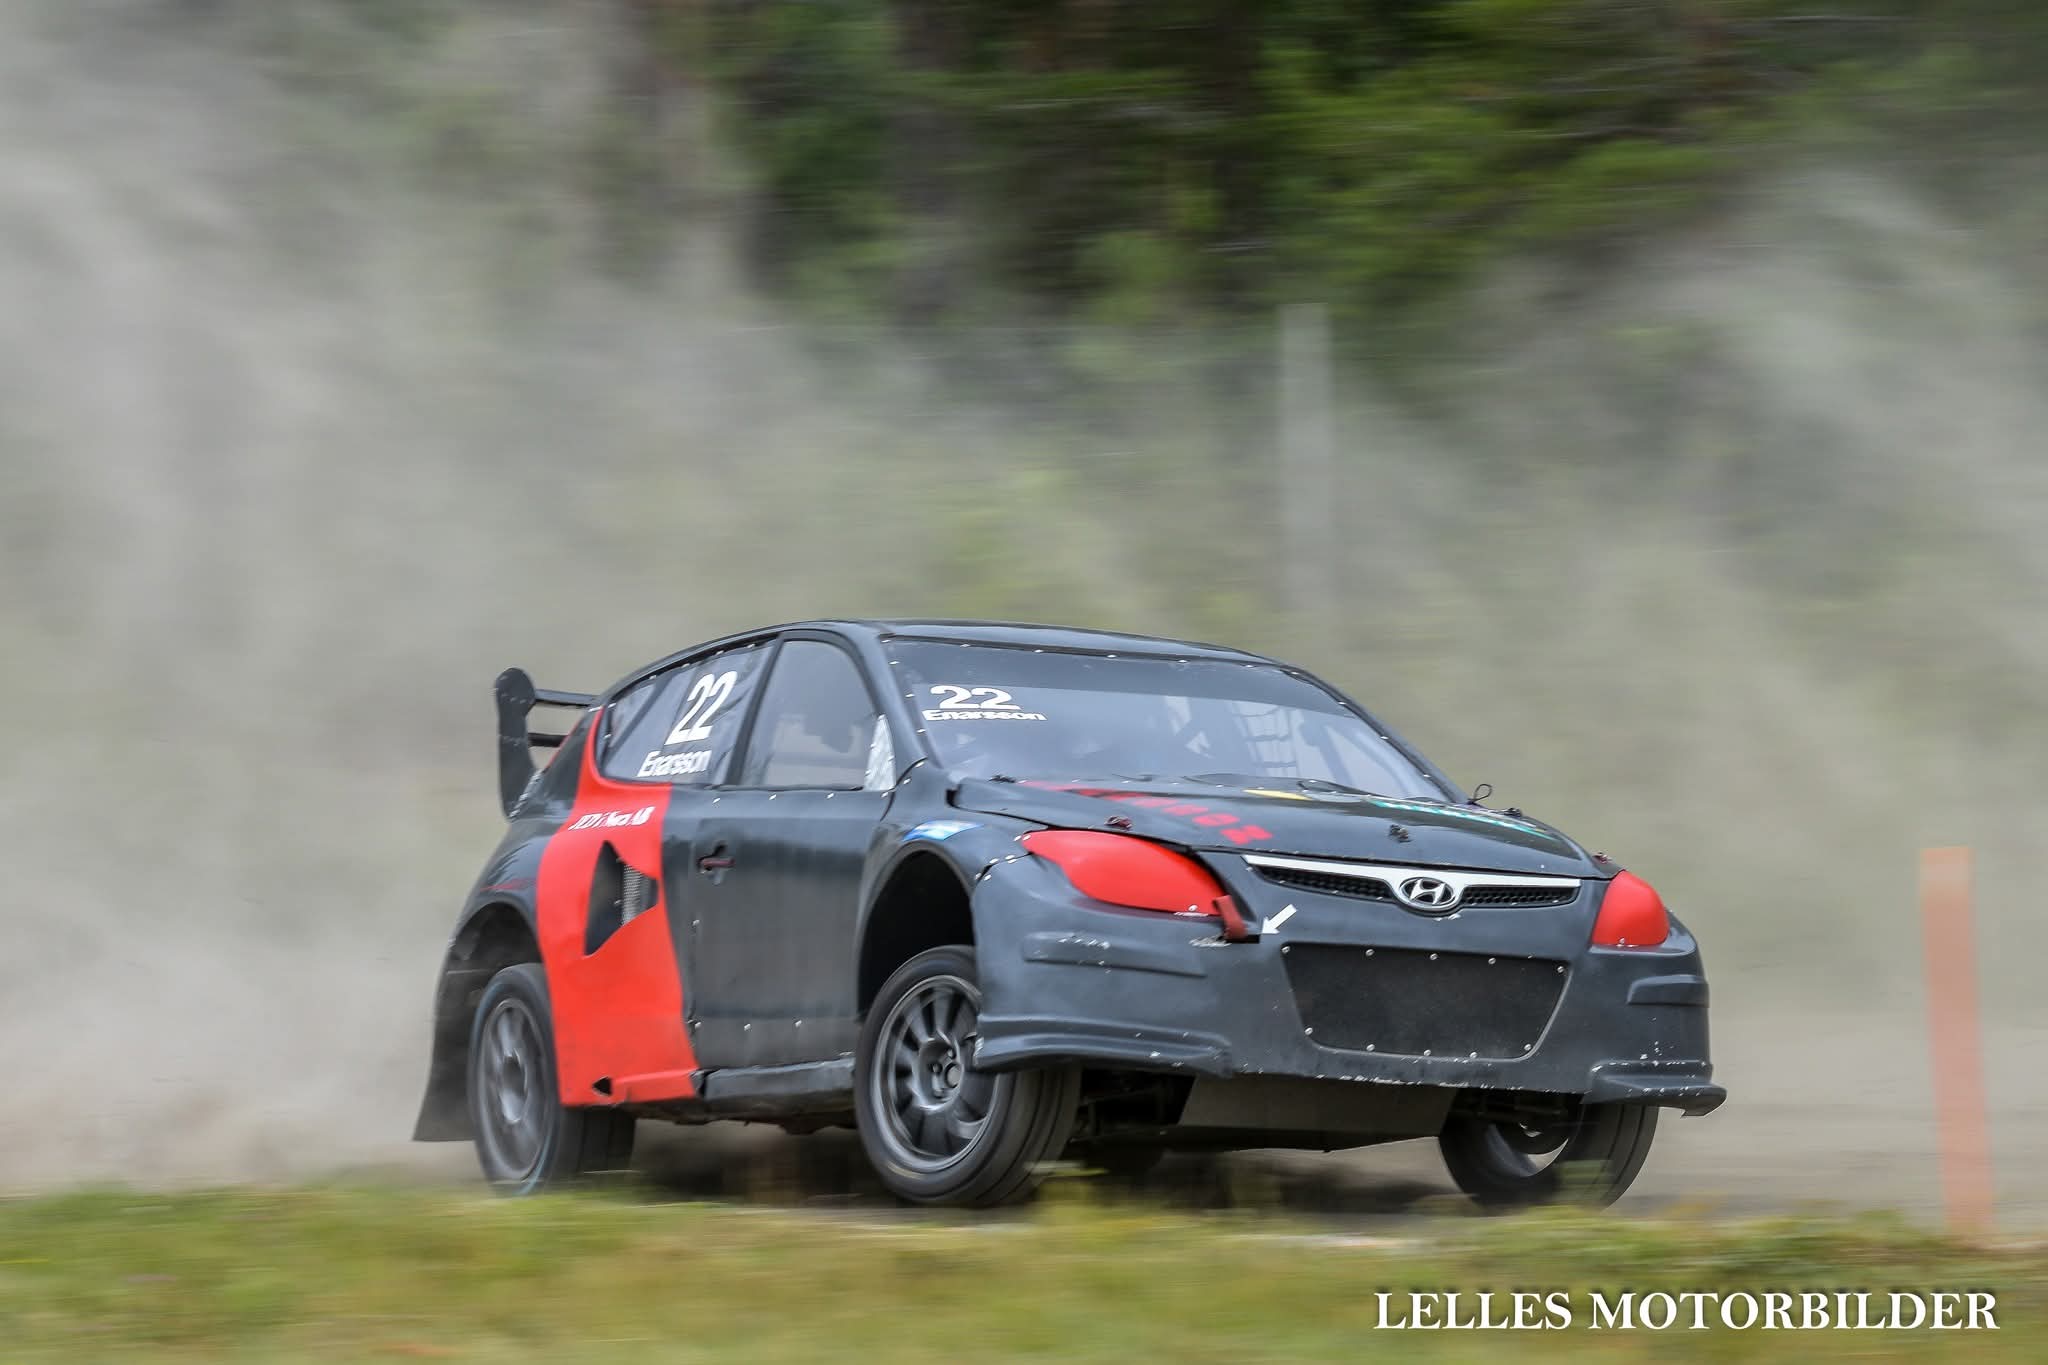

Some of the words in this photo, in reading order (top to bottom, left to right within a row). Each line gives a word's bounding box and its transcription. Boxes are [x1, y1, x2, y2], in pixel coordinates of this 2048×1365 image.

[664, 671, 738, 745] 22
[930, 685, 1021, 710] 22
[921, 709, 1048, 721] Enarsson
